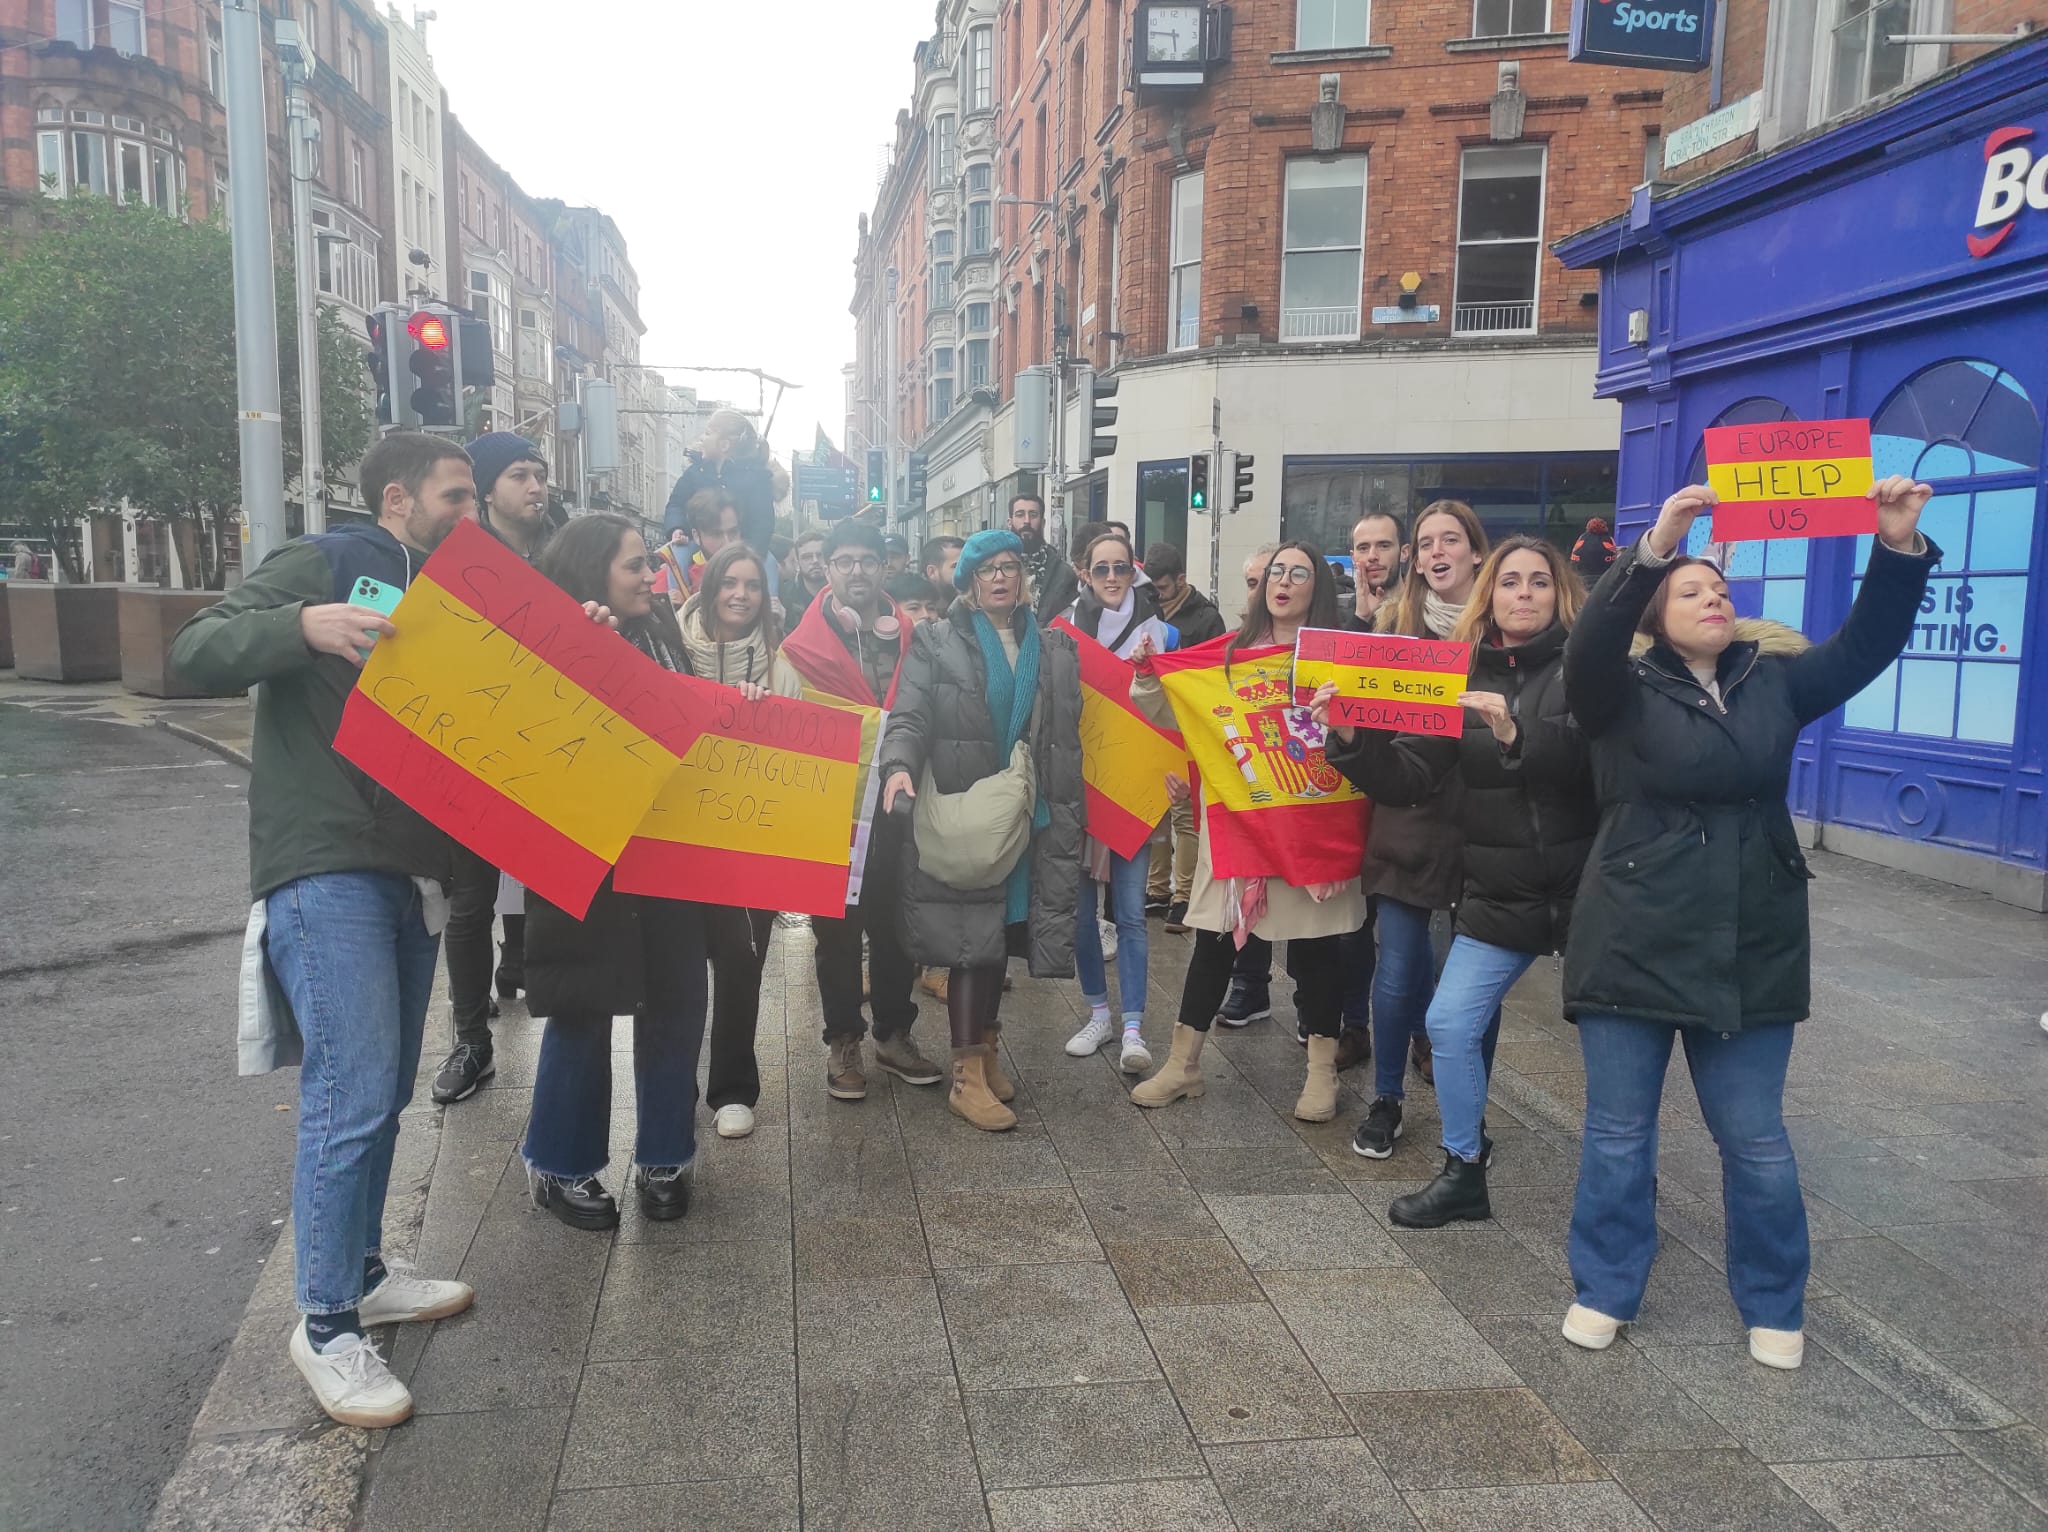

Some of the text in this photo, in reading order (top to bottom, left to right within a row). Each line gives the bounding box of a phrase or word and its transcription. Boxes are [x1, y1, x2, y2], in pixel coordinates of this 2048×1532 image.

[1613, 2, 1698, 33] Sports
[1738, 428, 1843, 455] EUROPE
[1734, 463, 1842, 498] HELP
[1769, 507, 1808, 531] US
[1945, 585, 1974, 614] IS
[440, 565, 690, 766] SANCHEZ
[1342, 640, 1463, 666] DEMOCRACY
[467, 684, 512, 716] A
[1358, 676, 1445, 697] IS BEING
[1339, 702, 1447, 730] VIOLATED
[373, 676, 540, 806] CARCEL
[733, 744, 830, 793] PAGUEN
[696, 788, 781, 827] PSOE
